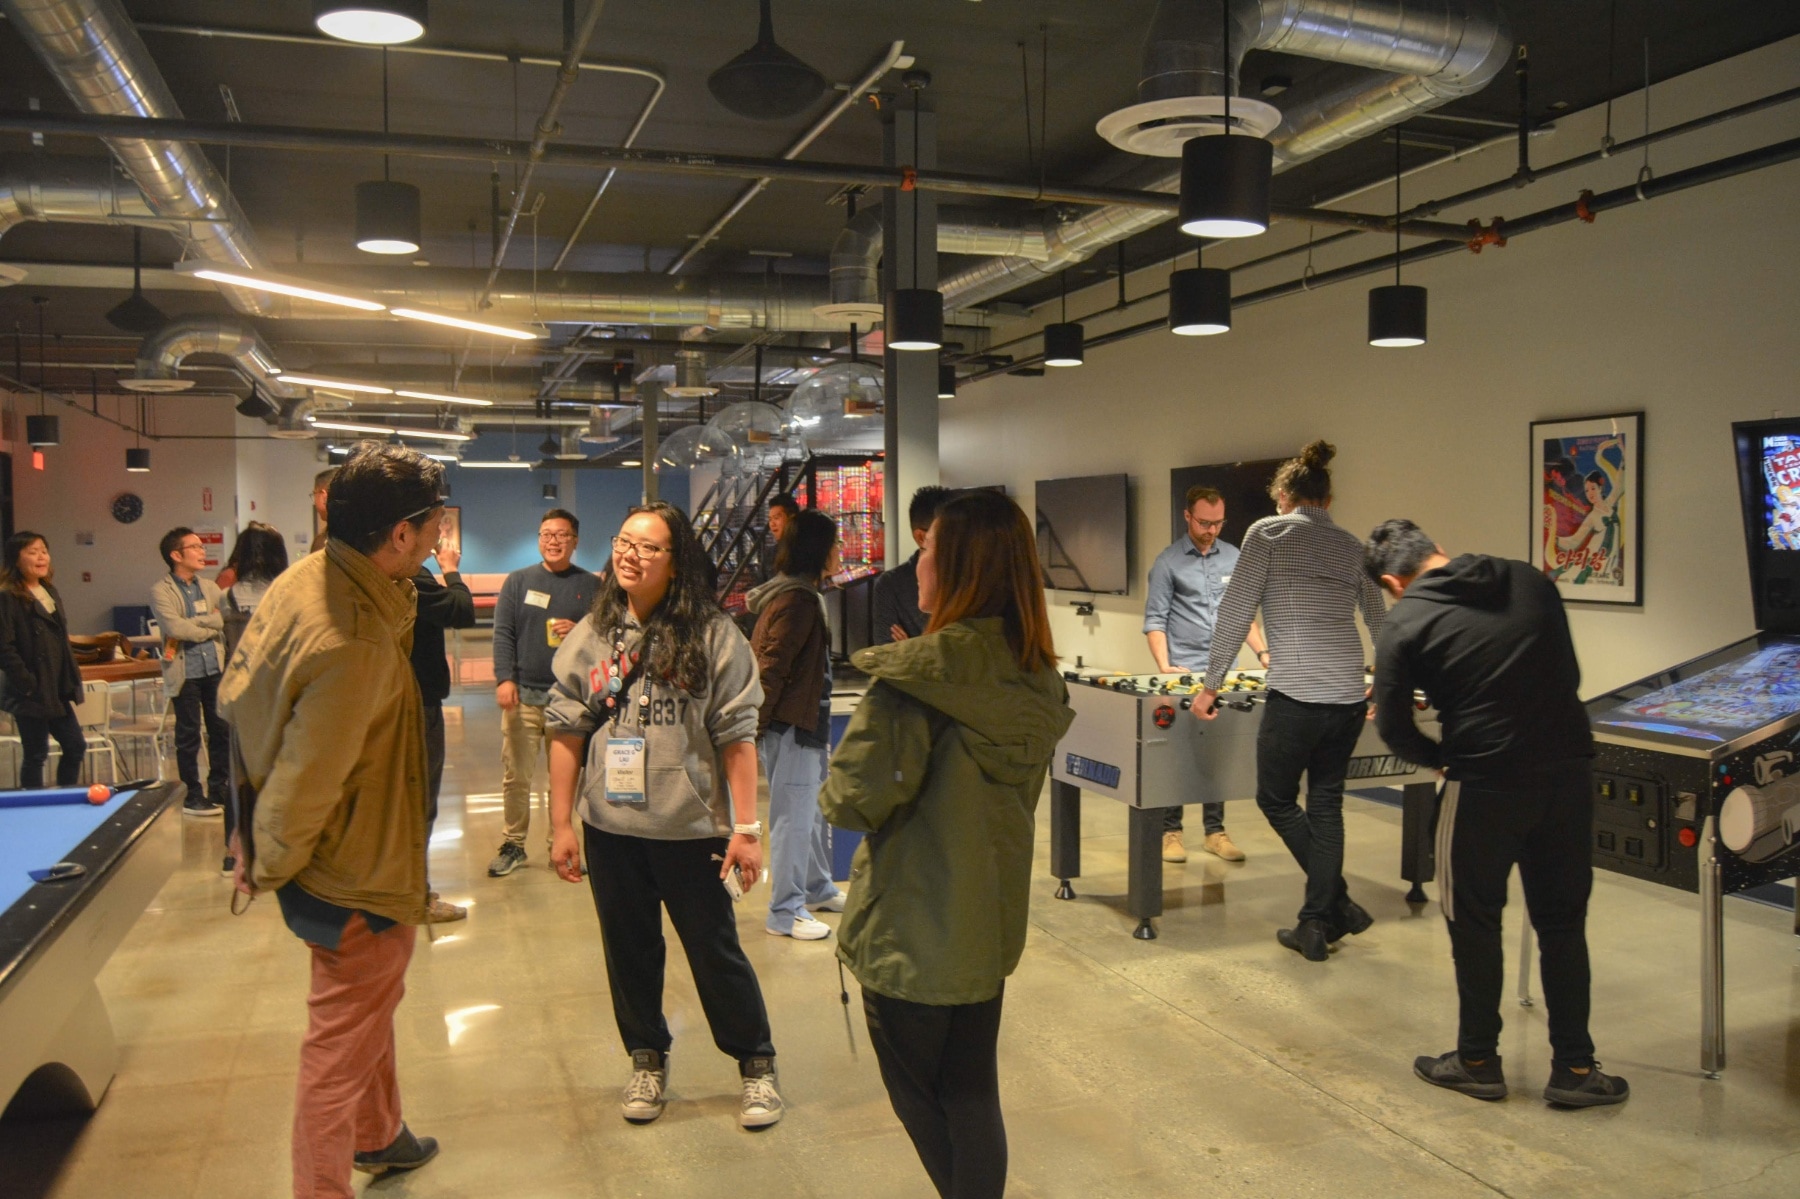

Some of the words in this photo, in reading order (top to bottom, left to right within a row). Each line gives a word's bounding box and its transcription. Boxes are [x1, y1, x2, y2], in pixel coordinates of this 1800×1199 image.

[1556, 547, 1607, 571] 아리랑
[644, 697, 689, 726] 837
[1067, 754, 1119, 788] TORNADO
[1345, 756, 1418, 779] ORNADO
